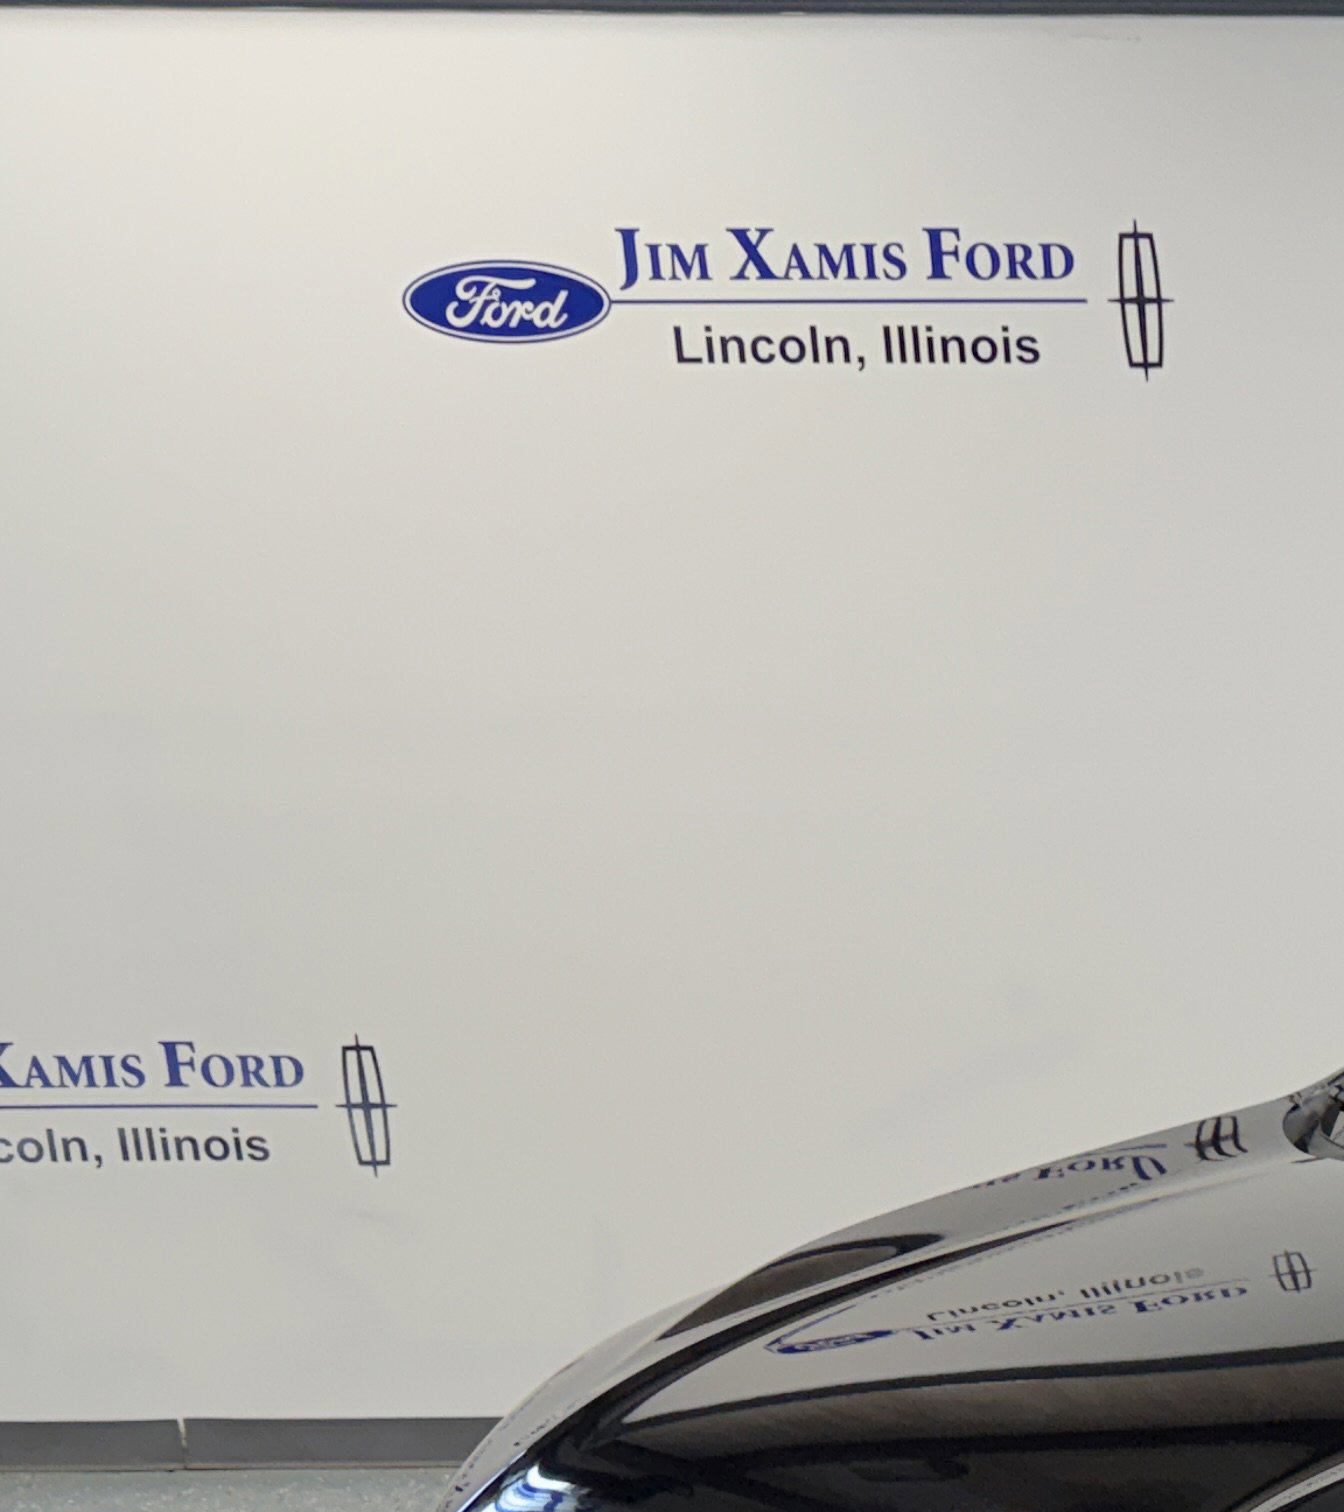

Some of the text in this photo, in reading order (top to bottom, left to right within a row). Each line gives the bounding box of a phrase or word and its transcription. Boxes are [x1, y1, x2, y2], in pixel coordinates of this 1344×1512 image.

[614, 227, 1075, 290] JIM XAMIS FORD
[446, 274, 569, 331] Ford
[673, 325, 1040, 371] Lincoln, Illinois
[157, 1041, 304, 1088] FORD
[117, 1127, 270, 1162] Illinois
